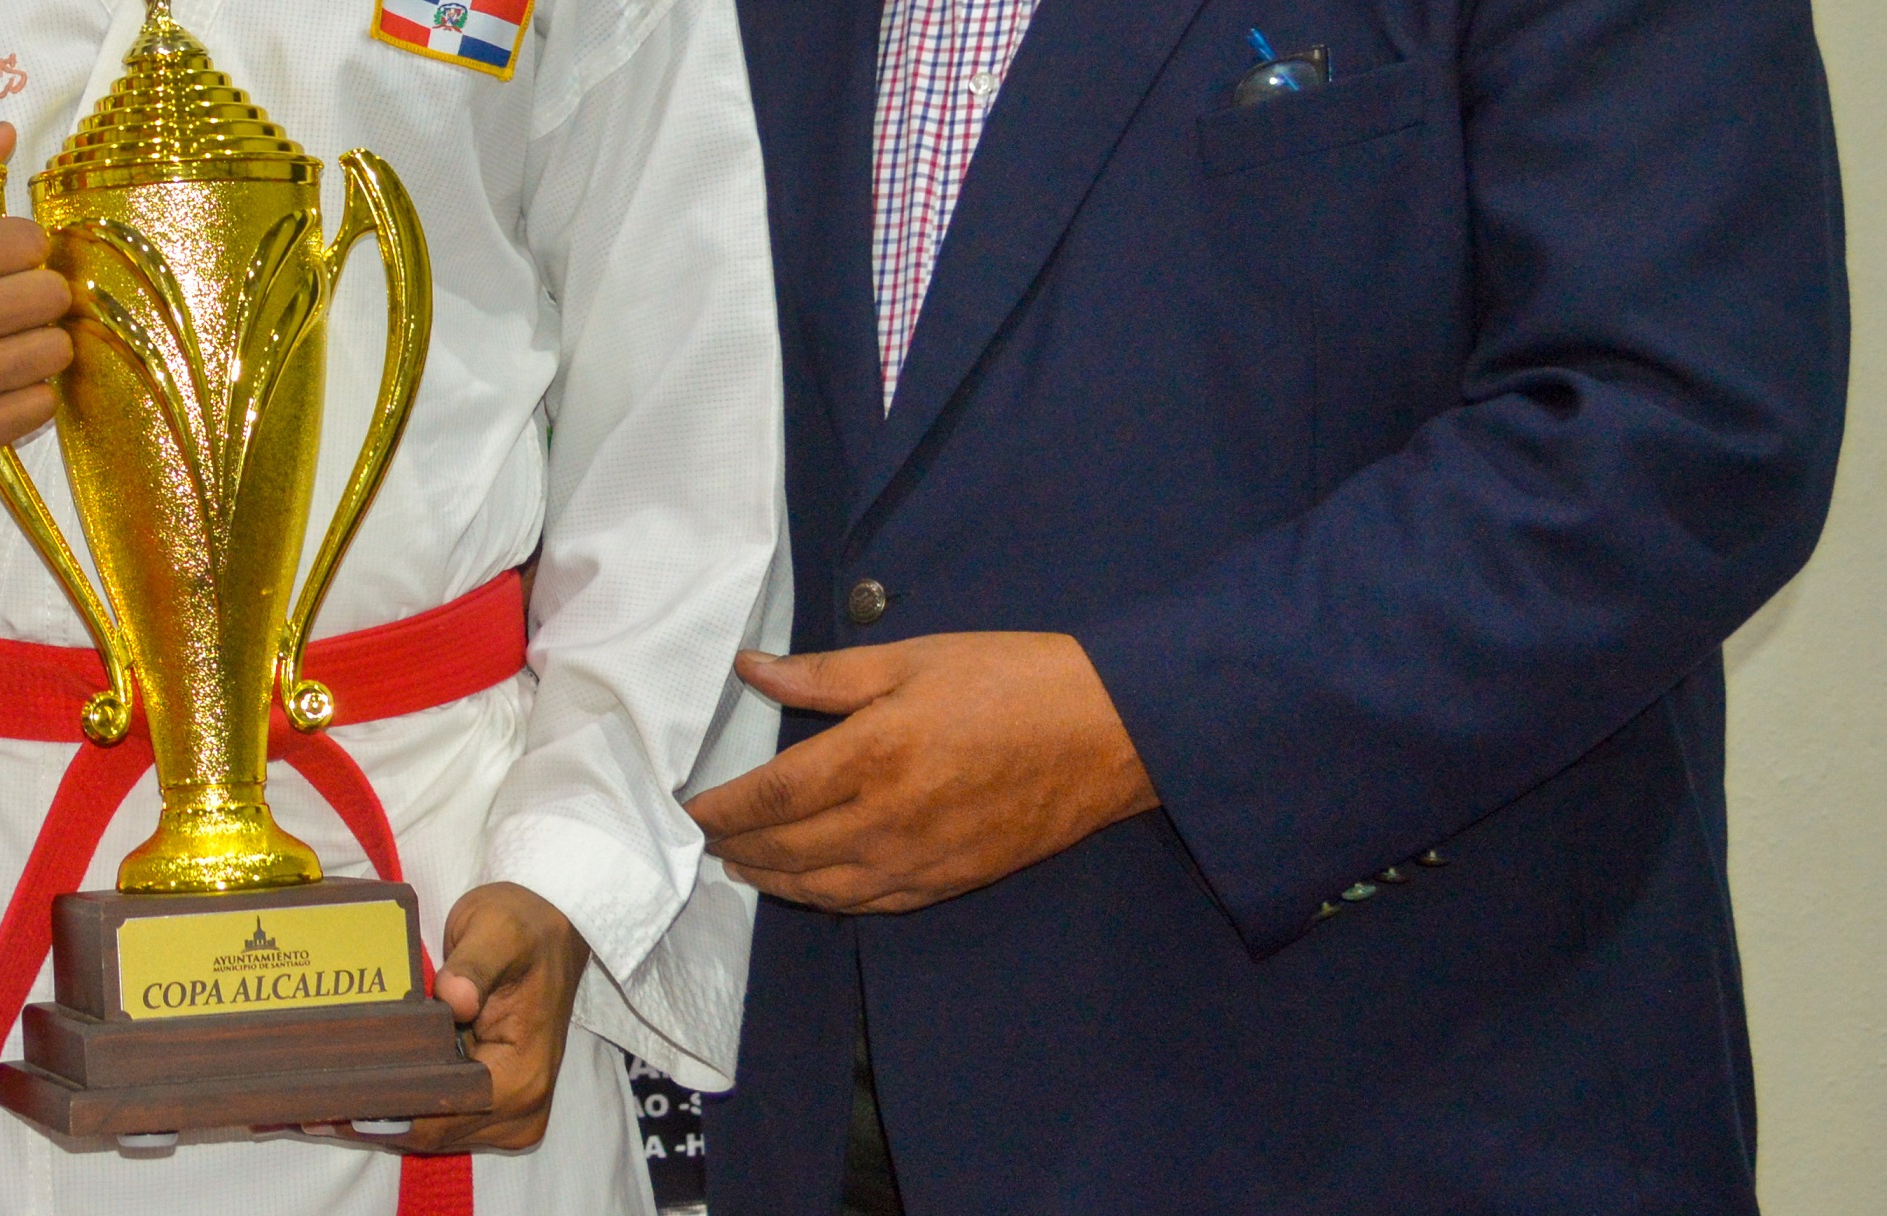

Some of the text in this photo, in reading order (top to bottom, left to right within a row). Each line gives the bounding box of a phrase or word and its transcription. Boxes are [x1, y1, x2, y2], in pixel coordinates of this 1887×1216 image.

[213, 949, 310, 966] AYUNTAMIENTO
[213, 959, 311, 973] MUNICIPIO DE SANTIAGO
[142, 966, 388, 1010] COPA ALCALDIA
